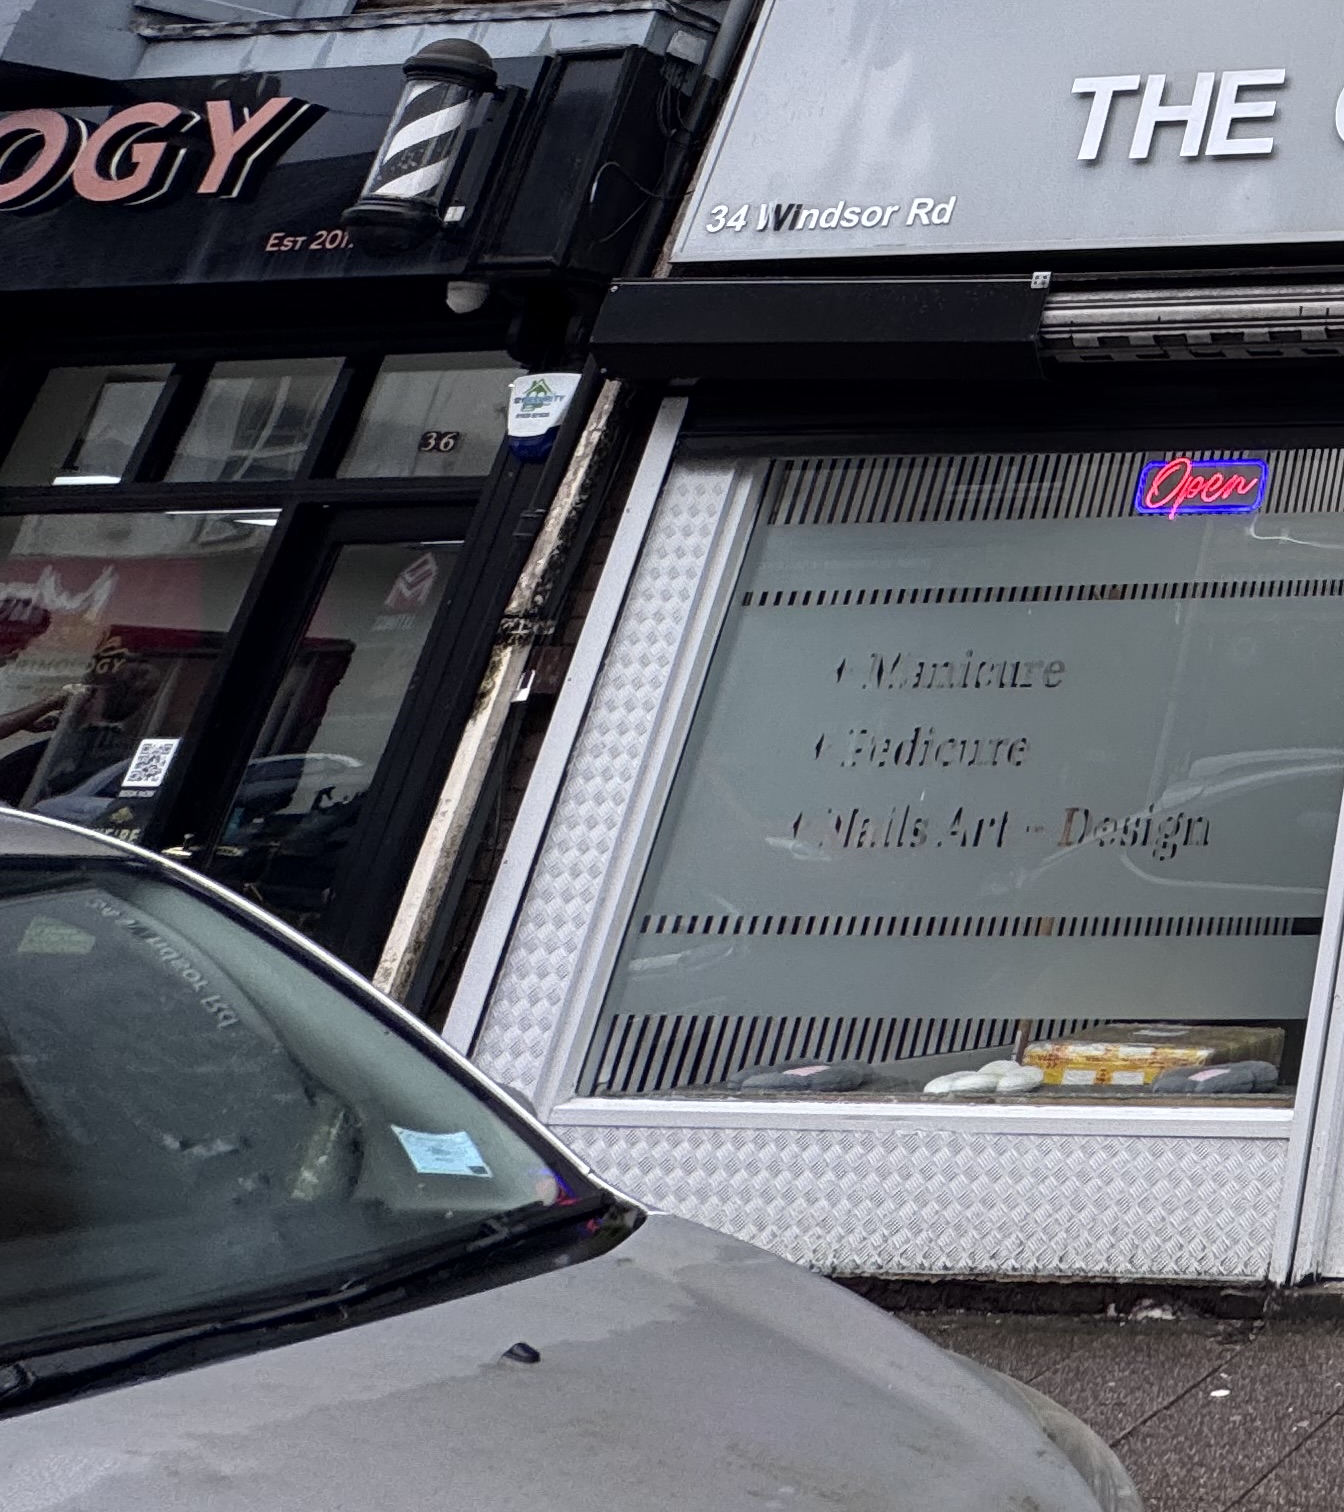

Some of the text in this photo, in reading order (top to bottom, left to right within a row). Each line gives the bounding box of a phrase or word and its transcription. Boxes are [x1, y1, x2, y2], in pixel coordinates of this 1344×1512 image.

[1070, 67, 1287, 163] THE
[0, 96, 300, 206] OGY
[705, 195, 958, 233] 34 Windsor Rd
[309, 229, 354, 250] 201
[420, 432, 457, 452] 36
[1145, 456, 1259, 521] Open
[862, 649, 1066, 689] Manicure
[818, 804, 929, 849] Nails
[937, 806, 1009, 848] Art
[1057, 803, 1211, 861] Design
